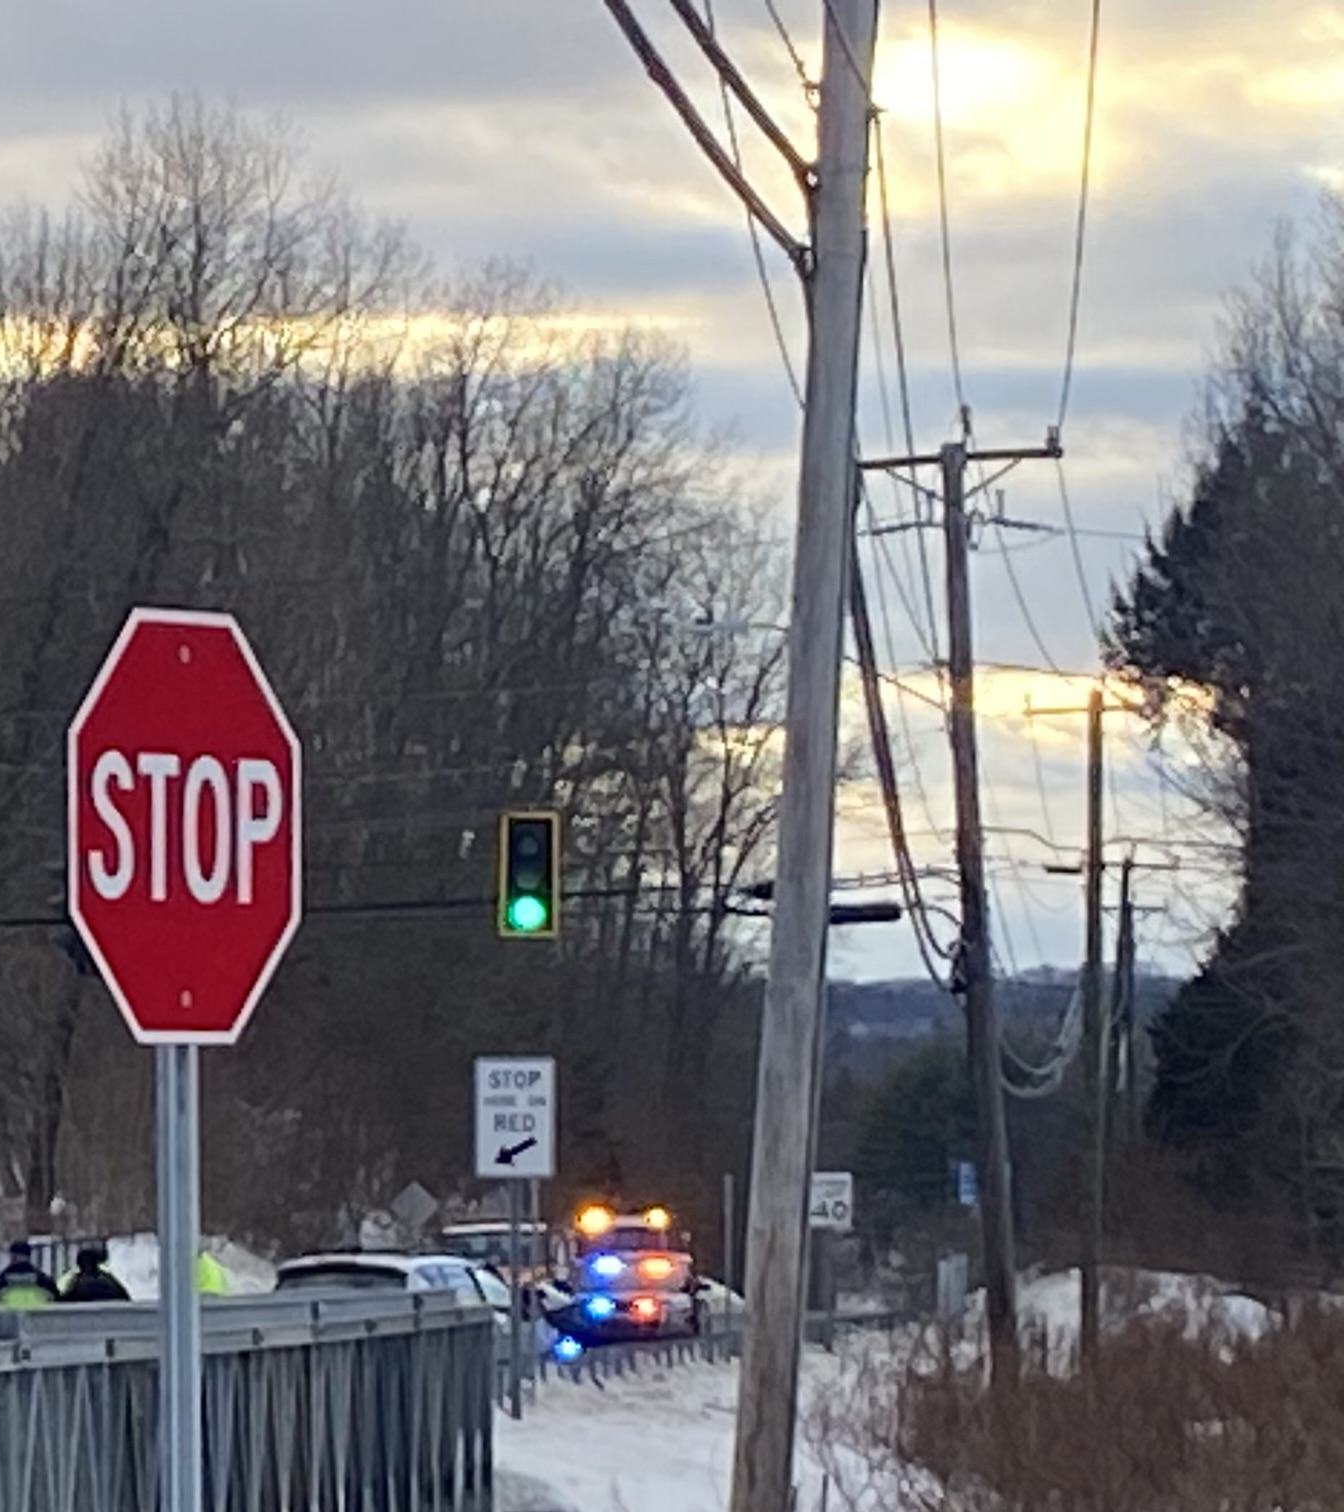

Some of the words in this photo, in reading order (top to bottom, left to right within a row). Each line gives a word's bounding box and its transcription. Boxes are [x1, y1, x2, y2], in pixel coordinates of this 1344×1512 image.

[87, 749, 283, 905] STOP
[488, 1069, 542, 1090] STOP
[494, 1113, 536, 1132] RED
[810, 1200, 848, 1221] 40
